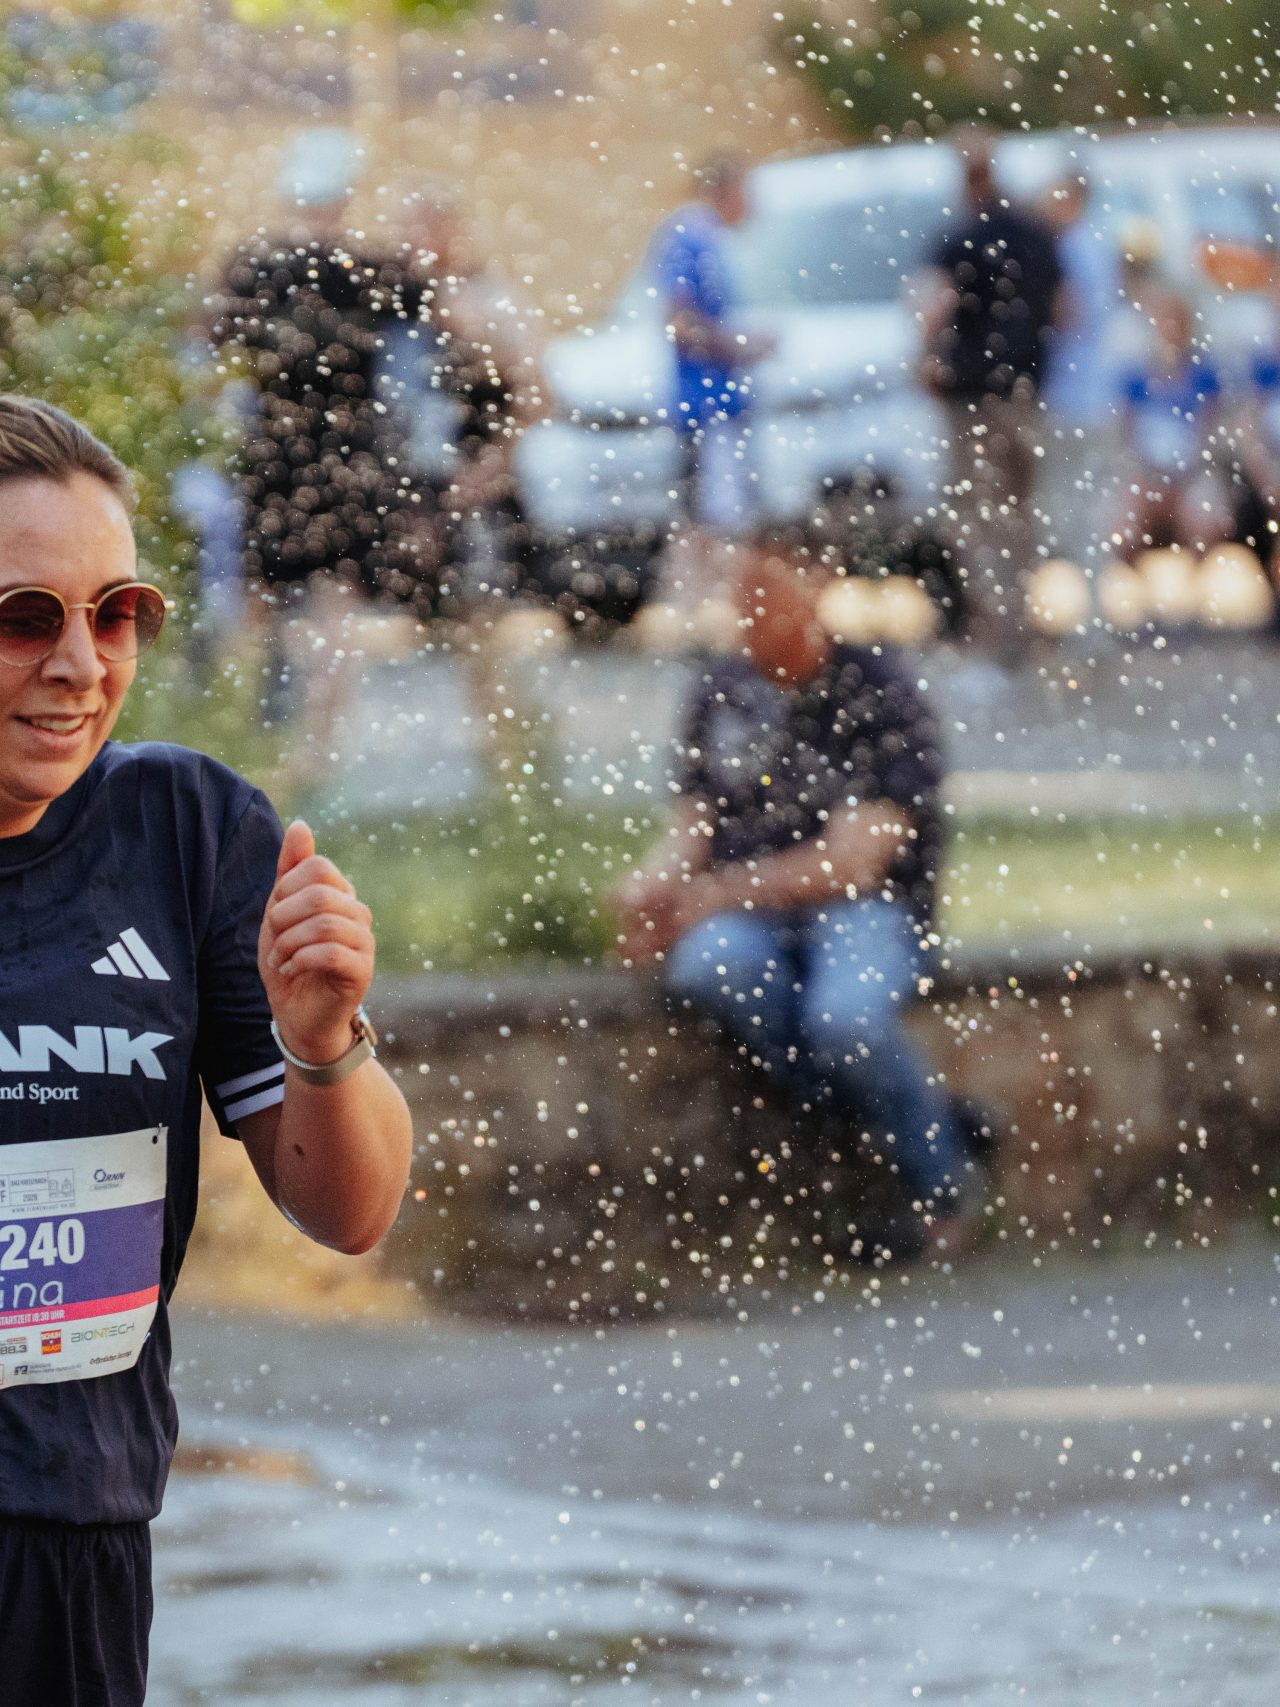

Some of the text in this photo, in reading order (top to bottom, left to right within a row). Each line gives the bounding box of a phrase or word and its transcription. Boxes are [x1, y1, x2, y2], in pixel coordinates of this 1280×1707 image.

[28, 1083, 80, 1105] Sport
[50, 1309, 65, 1320] UHR
[70, 1321, 135, 1343] BIONTECH
[0, 1344, 28, 1355] 88.3
